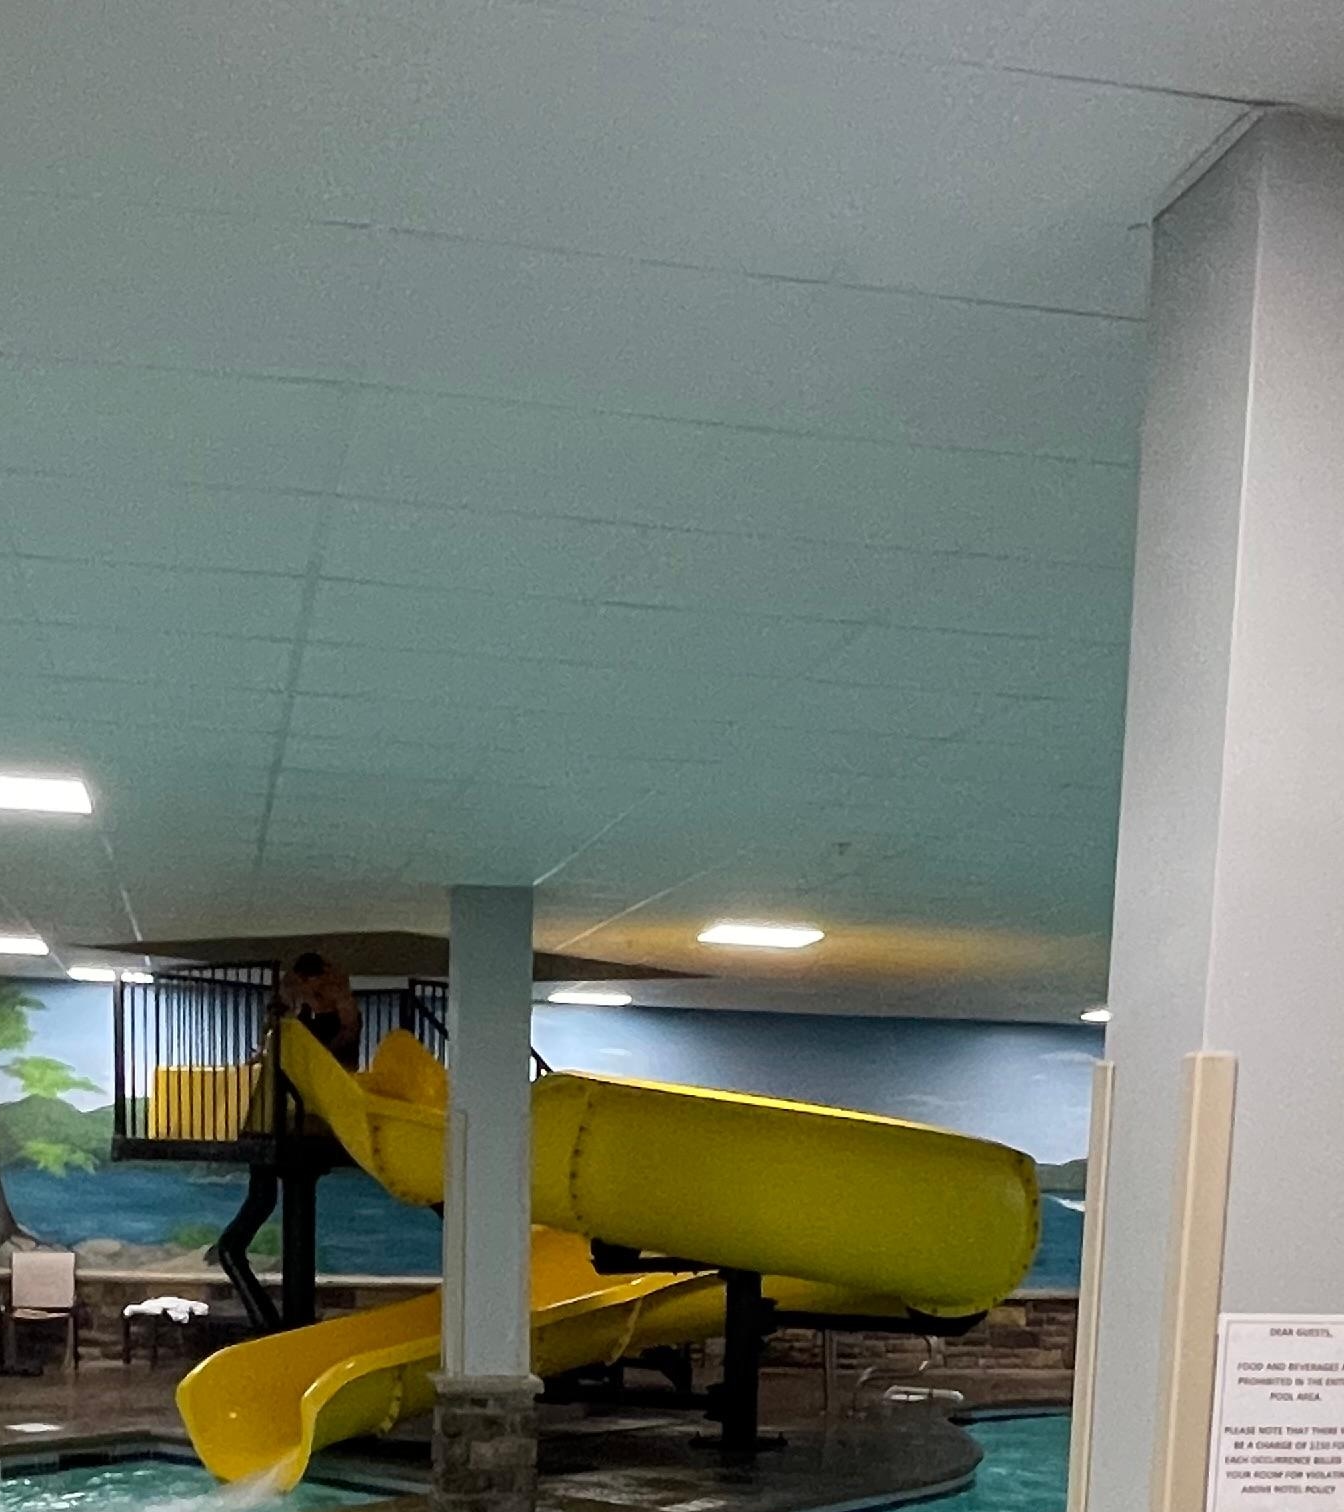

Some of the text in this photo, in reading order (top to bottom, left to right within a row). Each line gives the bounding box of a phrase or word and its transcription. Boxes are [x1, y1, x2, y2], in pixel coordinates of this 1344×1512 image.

[1270, 1328, 1293, 1336] DEAR
[1237, 1363, 1263, 1371] FOOD
[1266, 1363, 1285, 1371] AND
[1288, 1363, 1339, 1371] BEVERAGES
[1238, 1377, 1292, 1385] PROHIBITED
[1307, 1378, 1322, 1386] THE
[1270, 1393, 1293, 1401] POOL
[1224, 1427, 1255, 1435] PLEASE
[1259, 1427, 1282, 1435] NOTE
[1286, 1427, 1309, 1435] THAT
[1312, 1427, 1337, 1435] THERE
[1234, 1441, 1244, 1449] BE
[1256, 1441, 1292, 1449] CHARGE
[1226, 1471, 1251, 1479] YOUR
[1254, 1471, 1283, 1479] ROOM
[1285, 1471, 1303, 1479] FOR
[1241, 1486, 1271, 1494] ABOVE
[1305, 1486, 1336, 1494] POLICY
